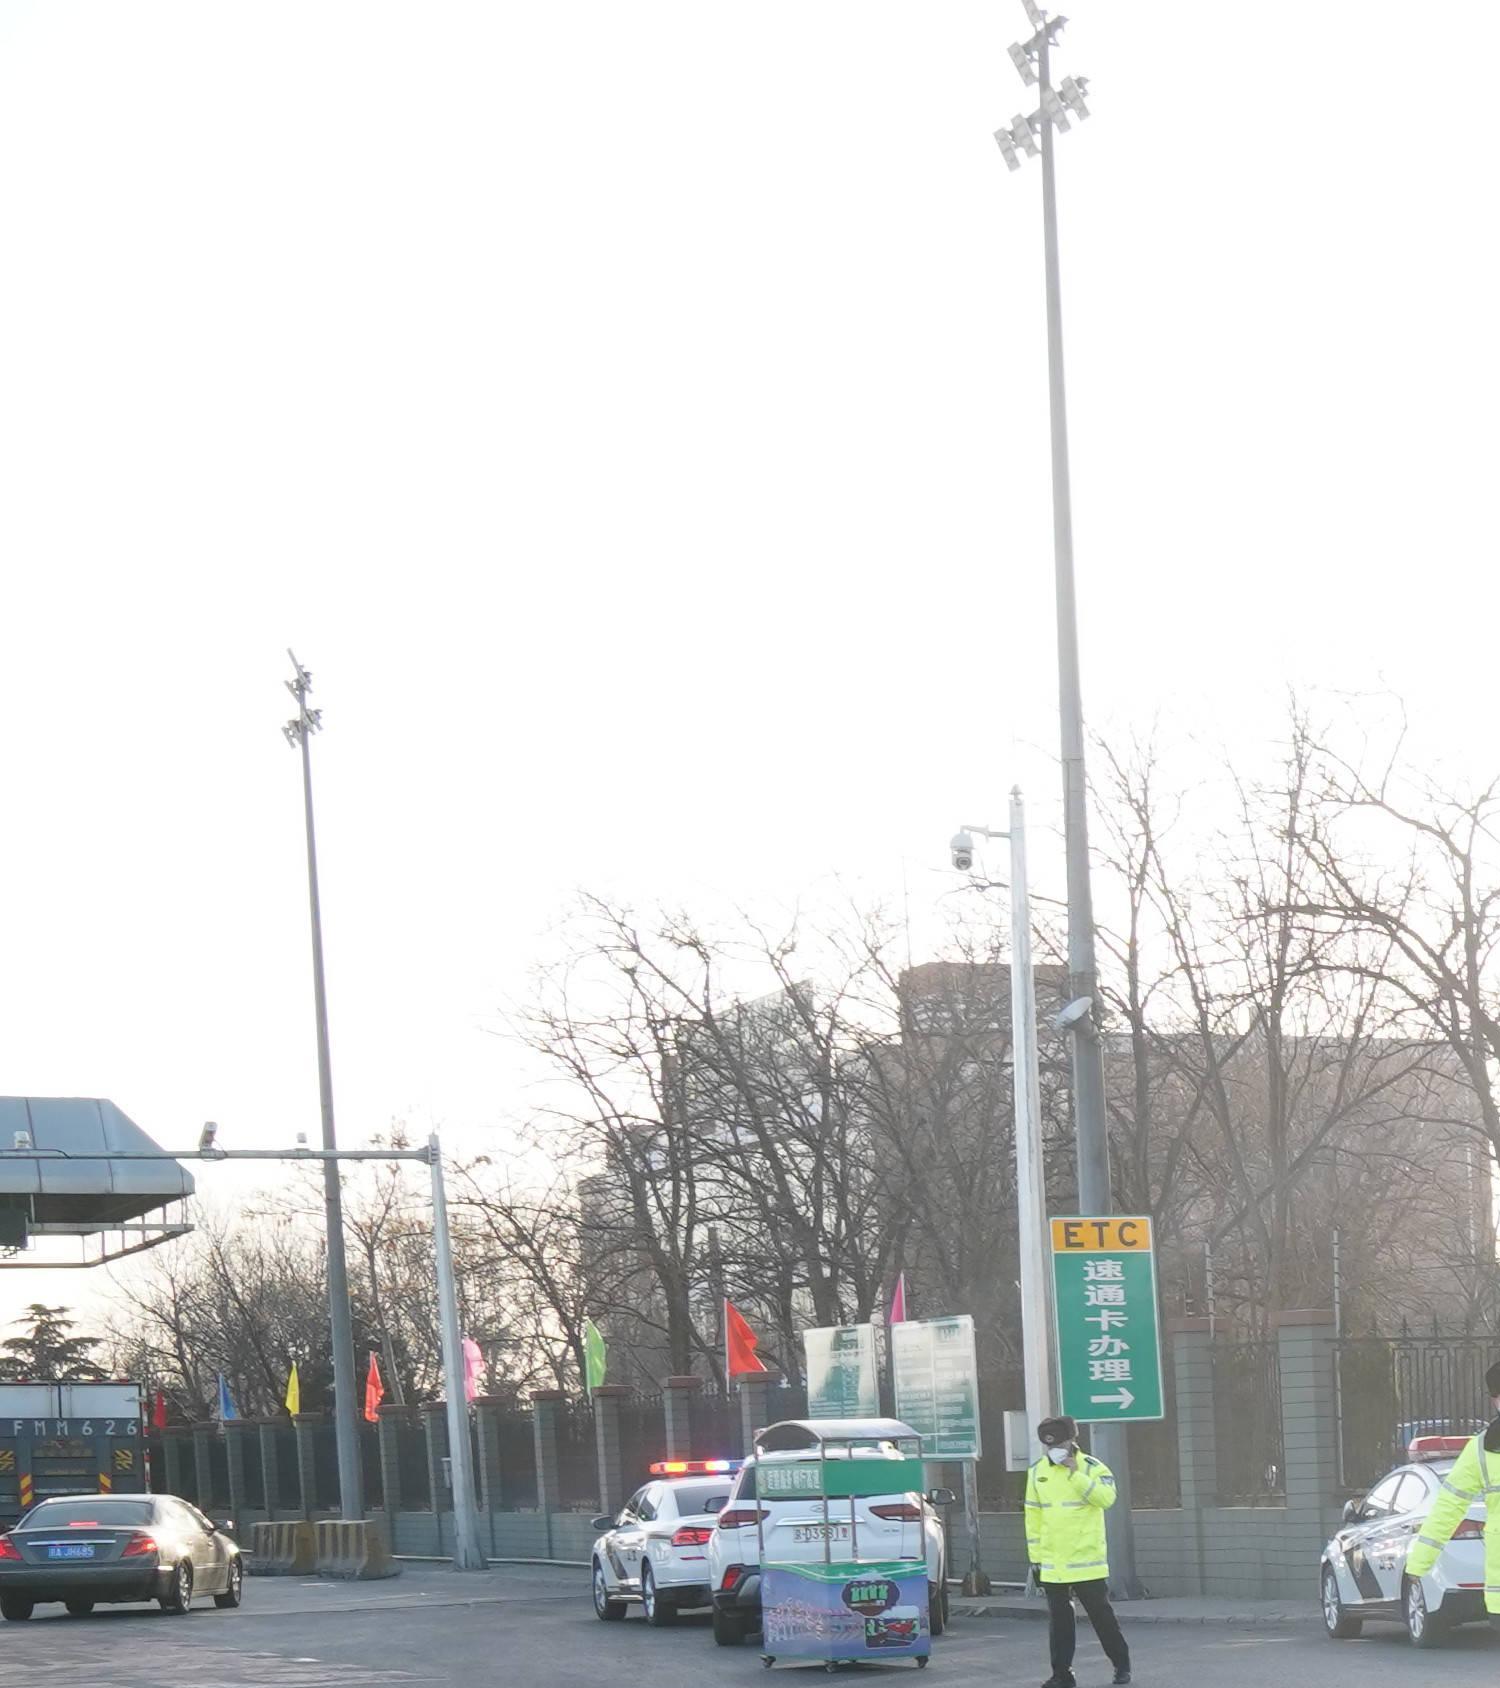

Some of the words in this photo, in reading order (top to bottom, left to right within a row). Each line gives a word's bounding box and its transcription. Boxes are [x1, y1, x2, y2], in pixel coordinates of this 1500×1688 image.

[1063, 1221, 1138, 1248] ETC
[1083, 1259, 1133, 1382] 速通卡办理
[13, 1420, 138, 1437] FMM626
